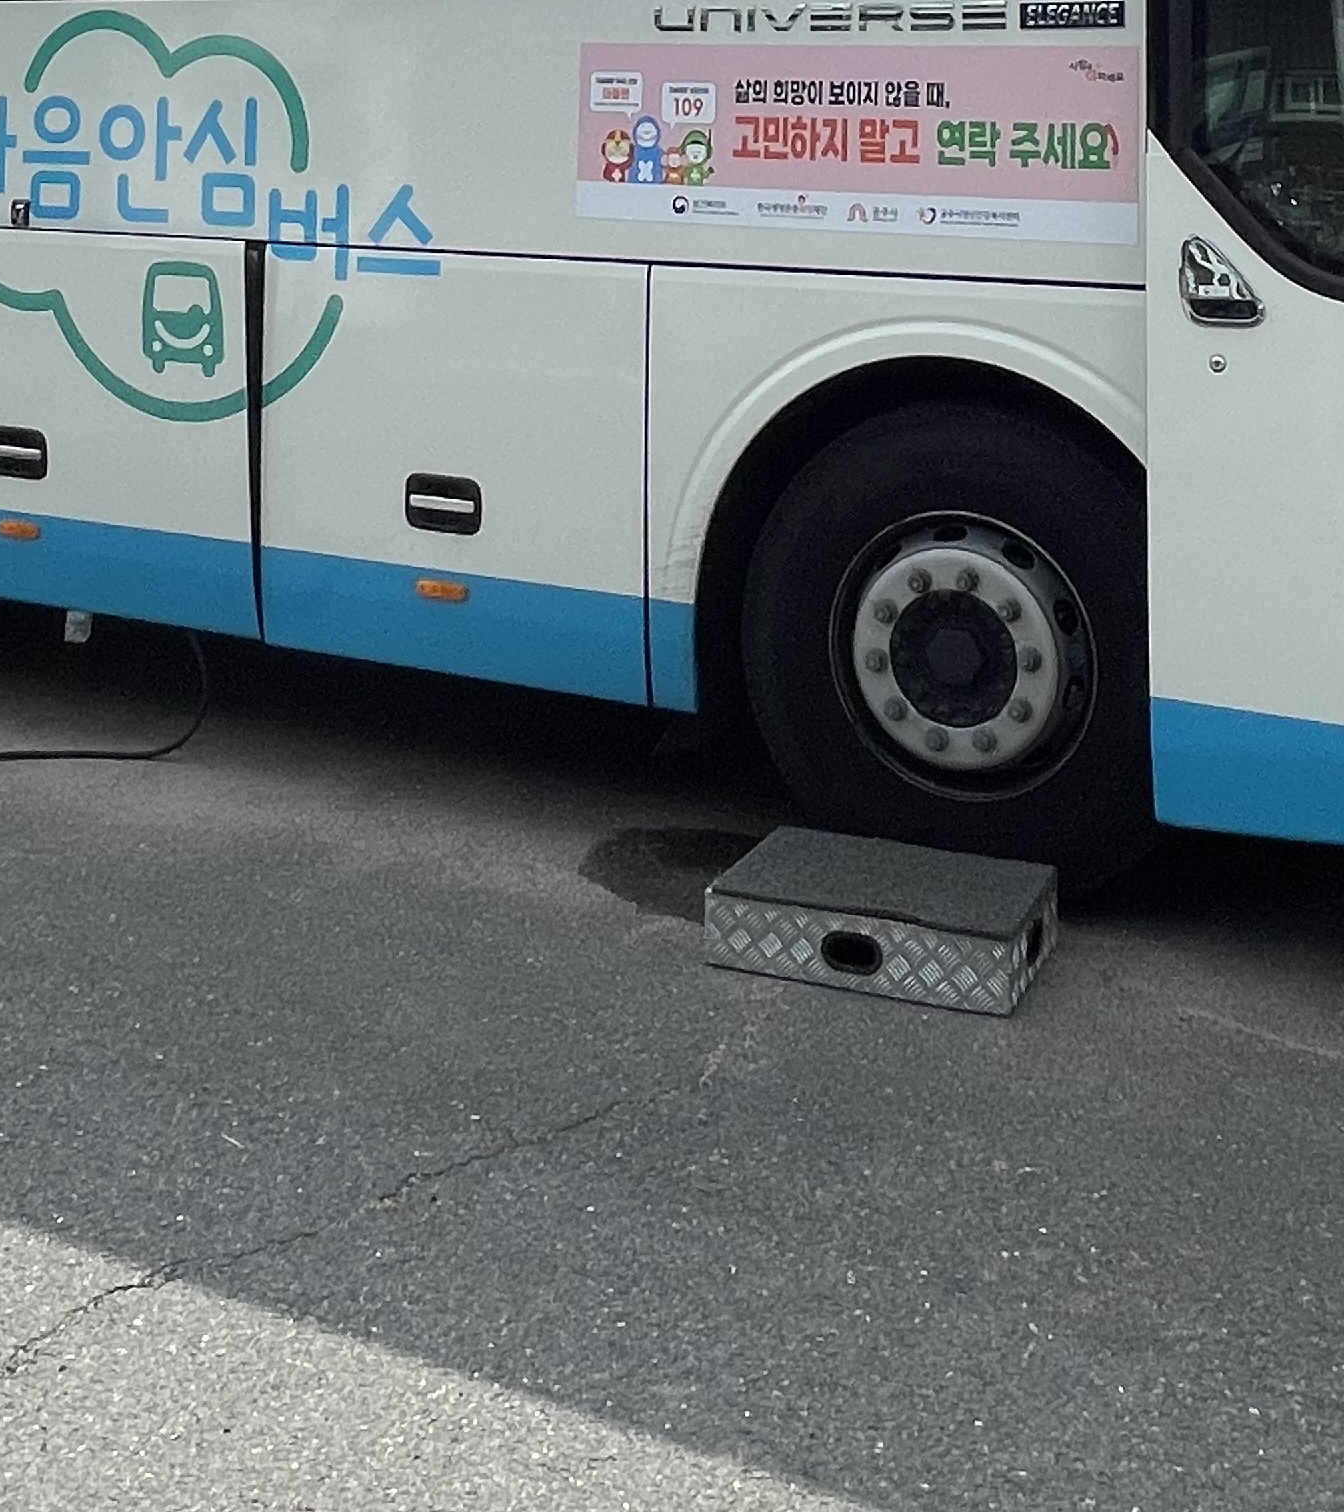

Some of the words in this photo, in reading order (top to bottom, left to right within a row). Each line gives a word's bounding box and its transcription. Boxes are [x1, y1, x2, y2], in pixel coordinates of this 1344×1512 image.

[654, 0, 1007, 32] UNIVERSE
[1025, 2, 1120, 27] ELEGANCE
[674, 97, 704, 116] 109
[735, 79, 768, 104] 삶의
[773, 80, 824, 105] 희망이
[828, 80, 880, 106] 보이지
[885, 81, 920, 107] 않을
[926, 82, 951, 109] 때,
[732, 115, 848, 163] 고민하지
[859, 118, 921, 164] 말고
[937, 120, 1002, 168] 연락
[1009, 122, 1111, 170] 주세요
[267, 183, 442, 282] 버스
